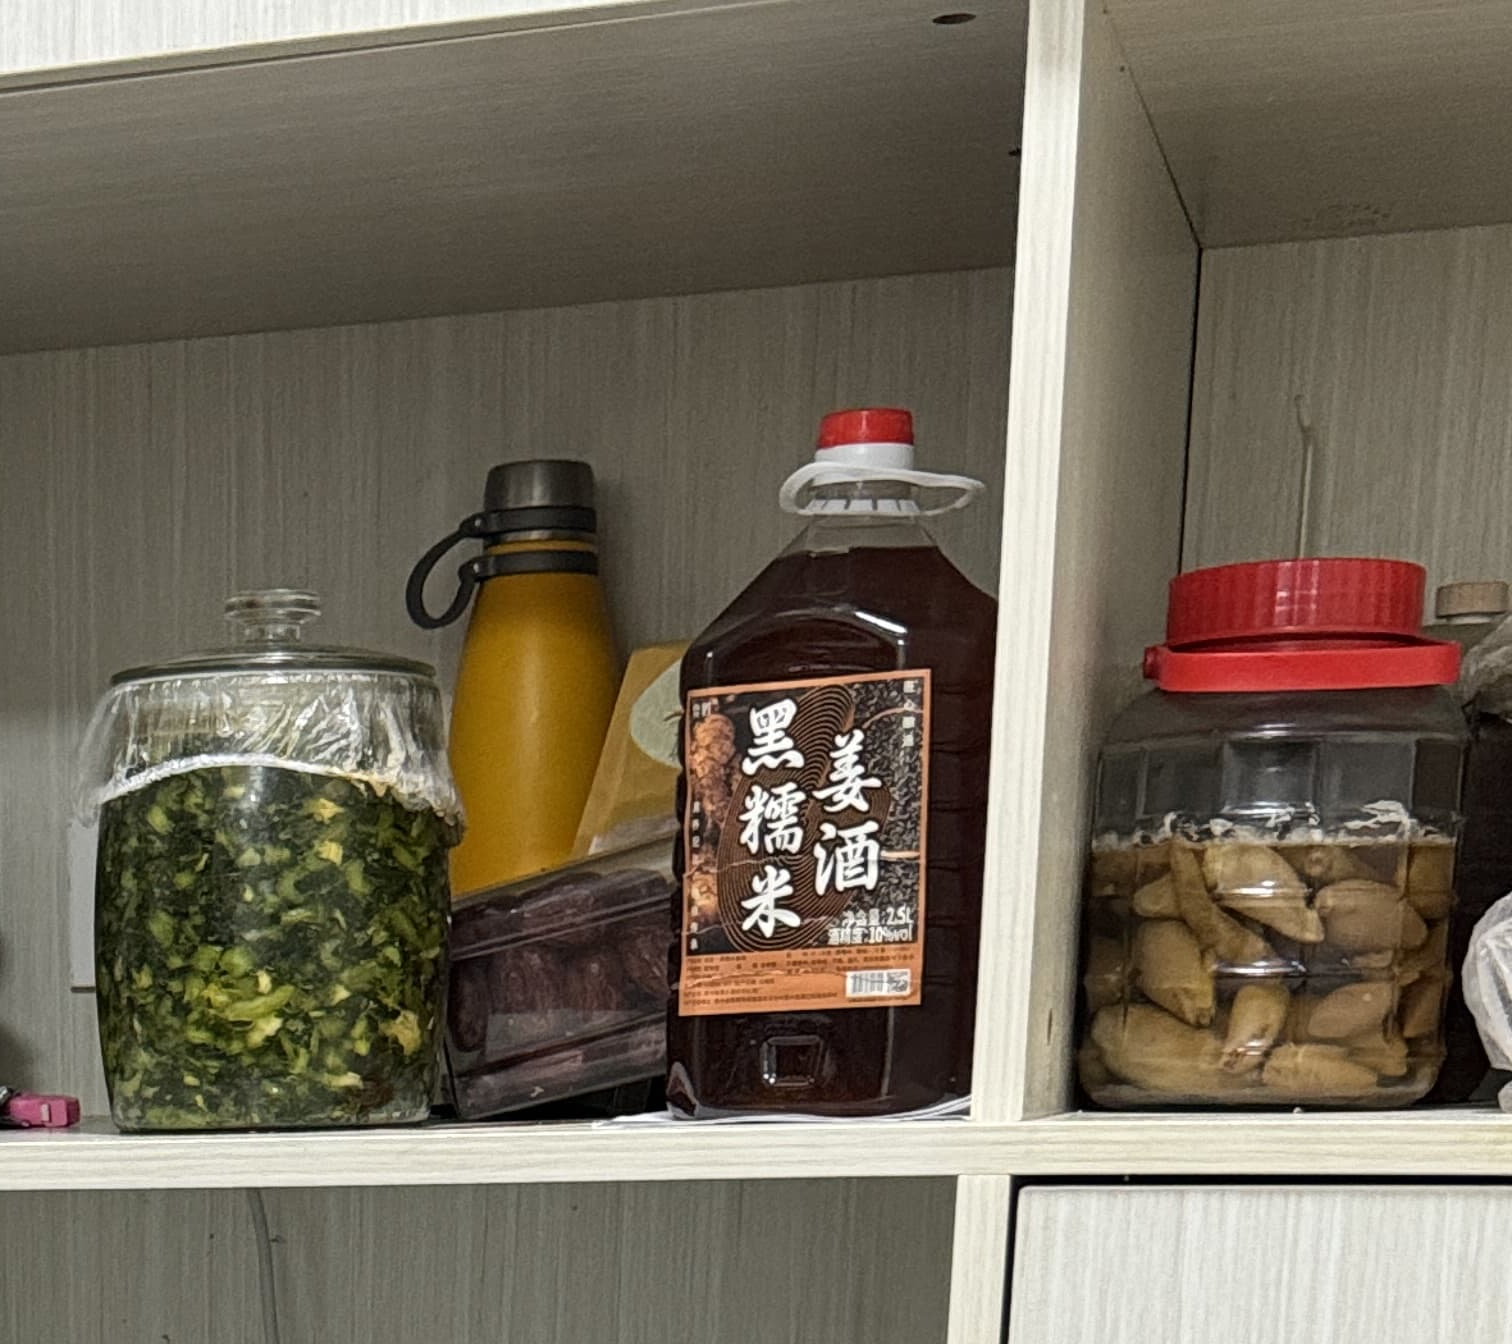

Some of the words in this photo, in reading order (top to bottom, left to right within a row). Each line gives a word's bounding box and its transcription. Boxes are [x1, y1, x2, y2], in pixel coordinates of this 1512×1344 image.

[739, 699, 805, 938] 黑糯米
[812, 729, 882, 896] 姜酒
